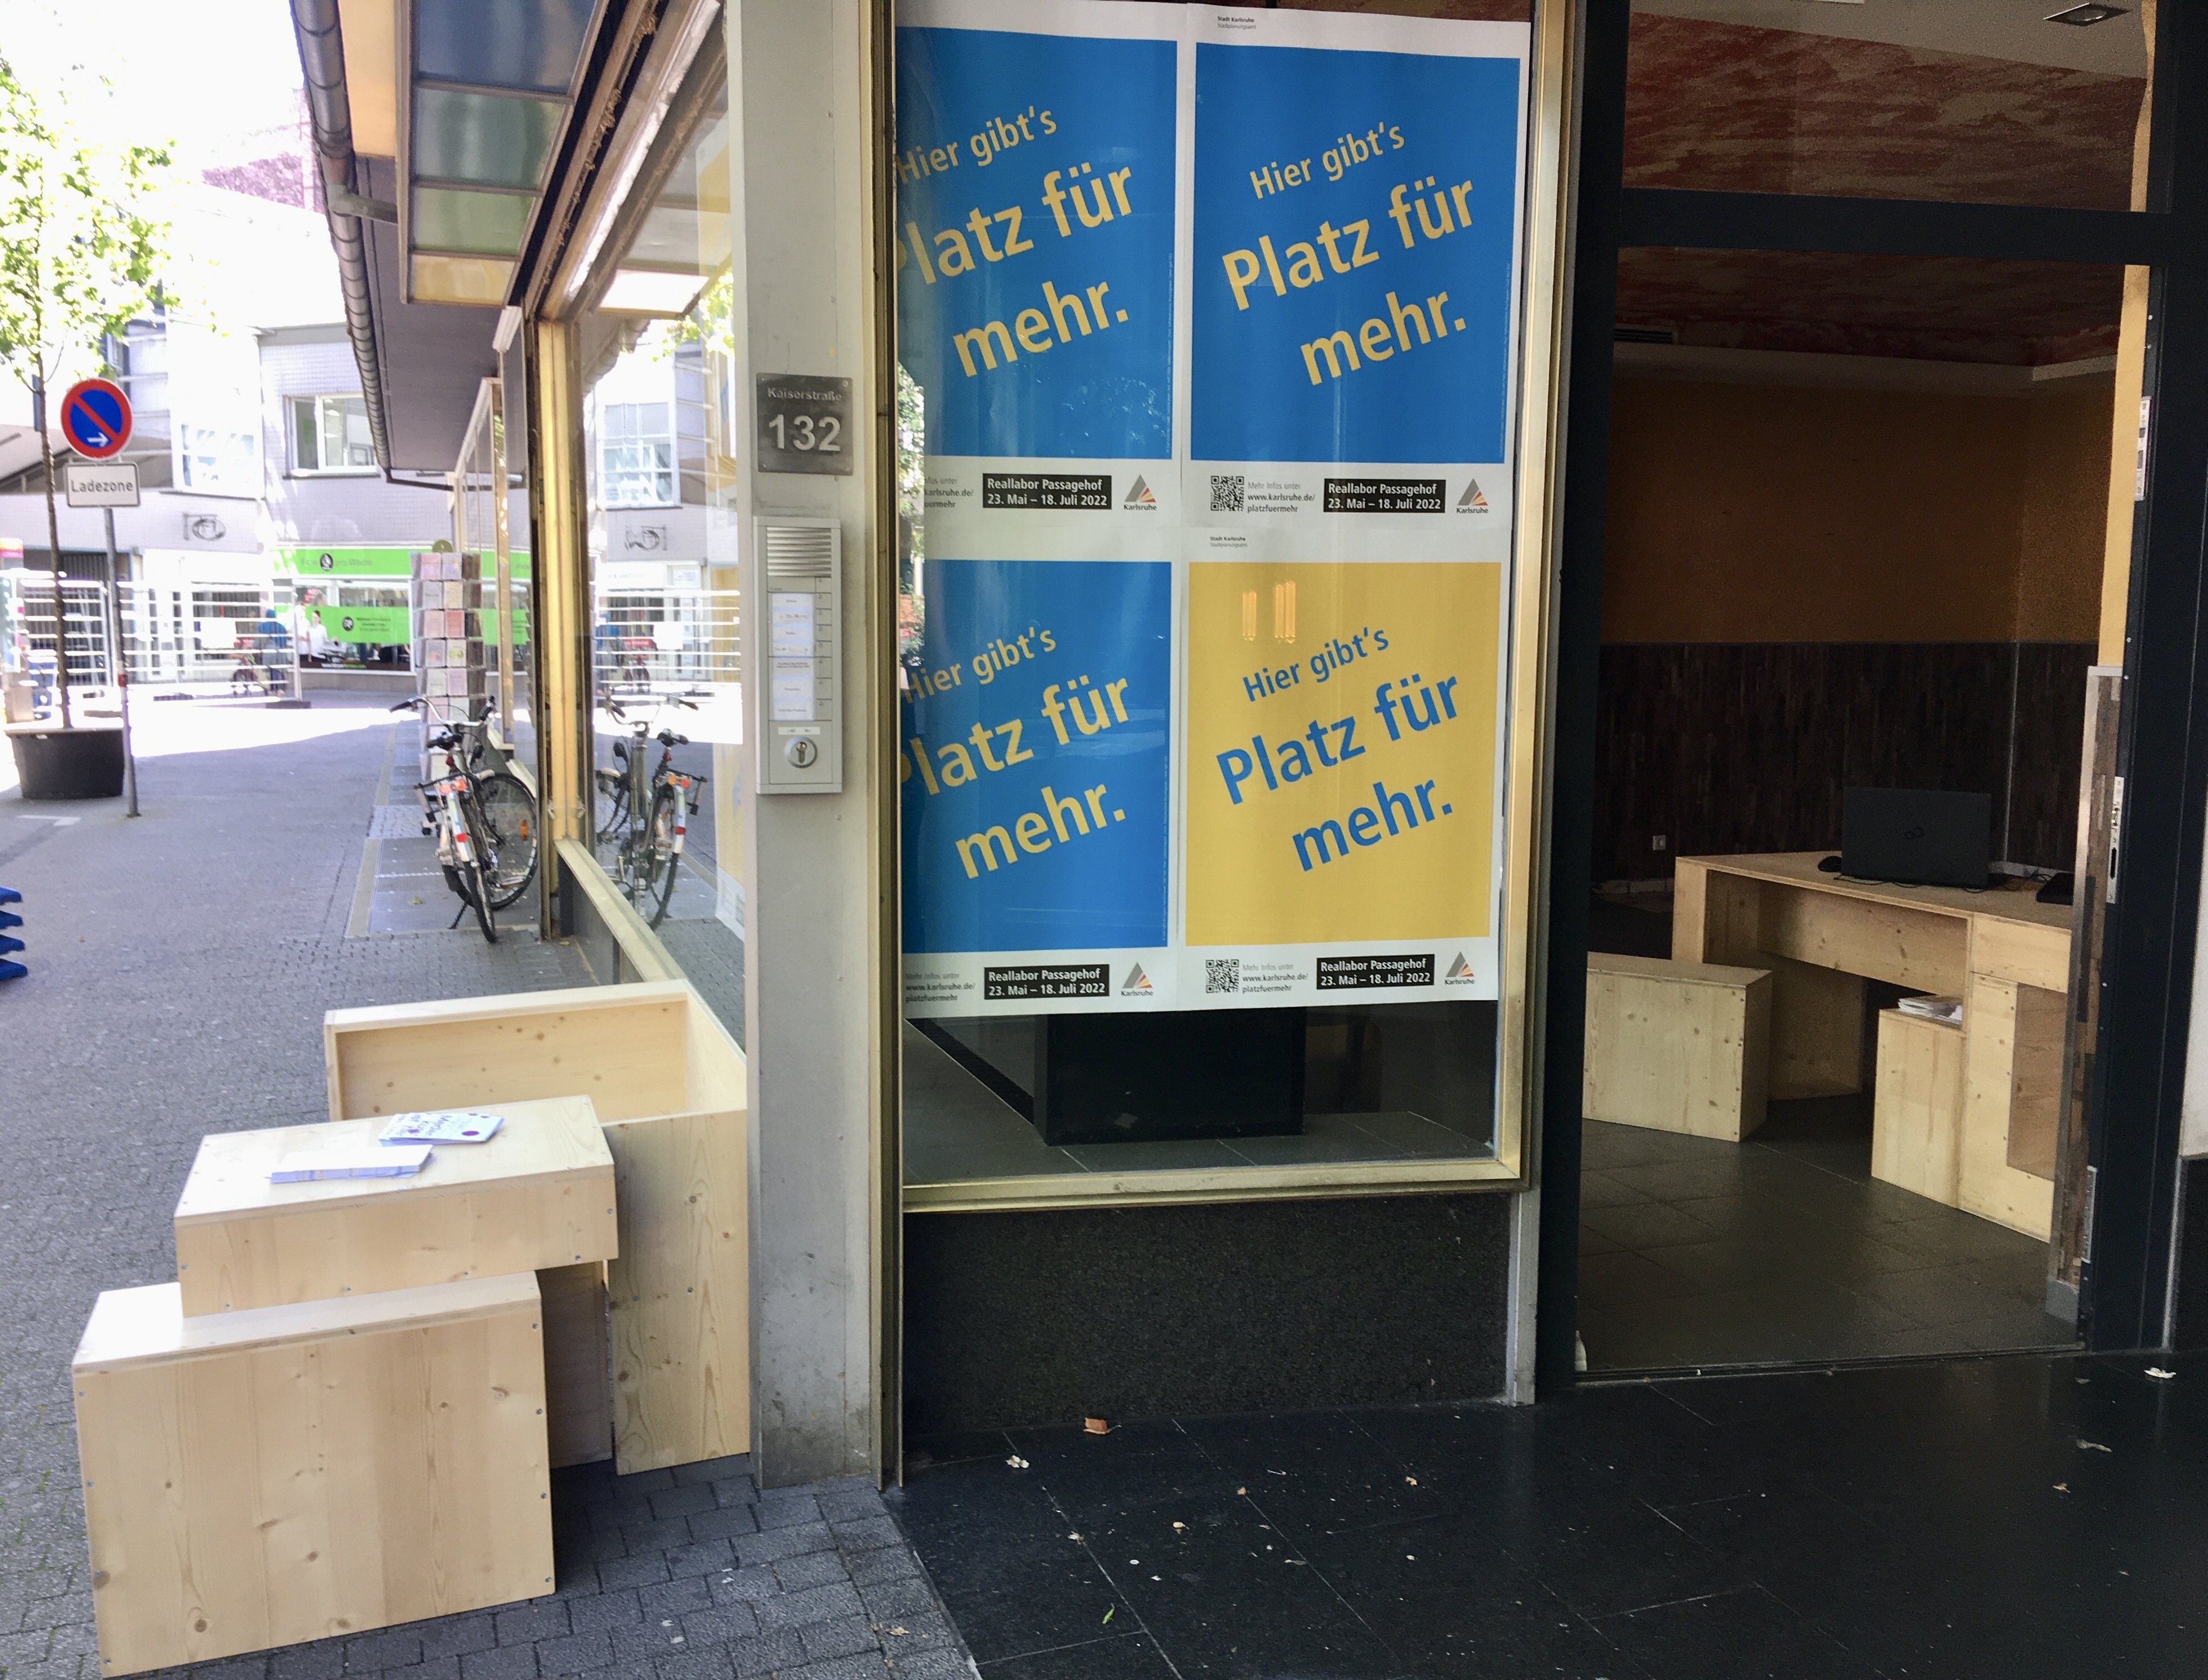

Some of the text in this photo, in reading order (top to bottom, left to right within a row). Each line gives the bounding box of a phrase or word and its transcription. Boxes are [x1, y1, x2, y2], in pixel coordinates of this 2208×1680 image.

[897, 140, 958, 185] Hier
[1251, 159, 1311, 200] Hier
[1042, 162, 1132, 238] für
[1222, 175, 1473, 312] Platz für
[953, 281, 1128, 377] mehr.
[1301, 291, 1466, 386] mehr.
[767, 386, 843, 402] Kaiserstraße
[768, 414, 842, 453] 132
[71, 478, 134, 493] Ladezone
[987, 478, 1103, 493] Reallabor Passagehof
[1247, 481, 1265, 489] Mehr
[1266, 482, 1282, 490] Infos
[1328, 482, 1437, 497] Reallabor Passagehof
[987, 493, 1005, 505] 23.
[1007, 494, 1027, 506] Mai
[1041, 494, 1057, 506] 18.
[1059, 494, 1078, 506] Juli
[1081, 494, 1107, 506] 2022
[1247, 492, 1316, 502] www.karlsruhe.de/
[1328, 497, 1344, 509] 23.
[1347, 498, 1366, 509] Mai
[1378, 498, 1393, 509] 18.
[1395, 498, 1413, 510] Juli
[1415, 498, 1441, 511] 2022
[1247, 504, 1298, 514] platzfuermehr
[901, 661, 962, 703] Hier
[1242, 664, 1300, 702] Hier
[901, 674, 1128, 796] latz für
[1216, 673, 1458, 806] Platz für
[955, 783, 1126, 879] mehr.
[1292, 778, 1453, 872] mehr.
[1242, 963, 1259, 972] Mehr
[1277, 962, 1294, 971] unter
[1320, 958, 1426, 973] Reallabor Passagehof
[988, 968, 1101, 982] Reallabor Passagehof
[1242, 972, 1308, 983] www.karlsruhe.de/
[1320, 975, 1336, 987] 23.
[1338, 974, 1358, 986] Mai
[1369, 974, 1384, 985] 18.
[1386, 973, 1403, 984] Juli
[1406, 972, 1431, 983] 2022
[988, 986, 1005, 997] 23.
[1008, 984, 1027, 996] Mai
[1041, 984, 1056, 995] 18.
[1058, 983, 1077, 994] Juli
[1079, 983, 1106, 994] 2022
[1242, 984, 1292, 994] platzfuermehr
